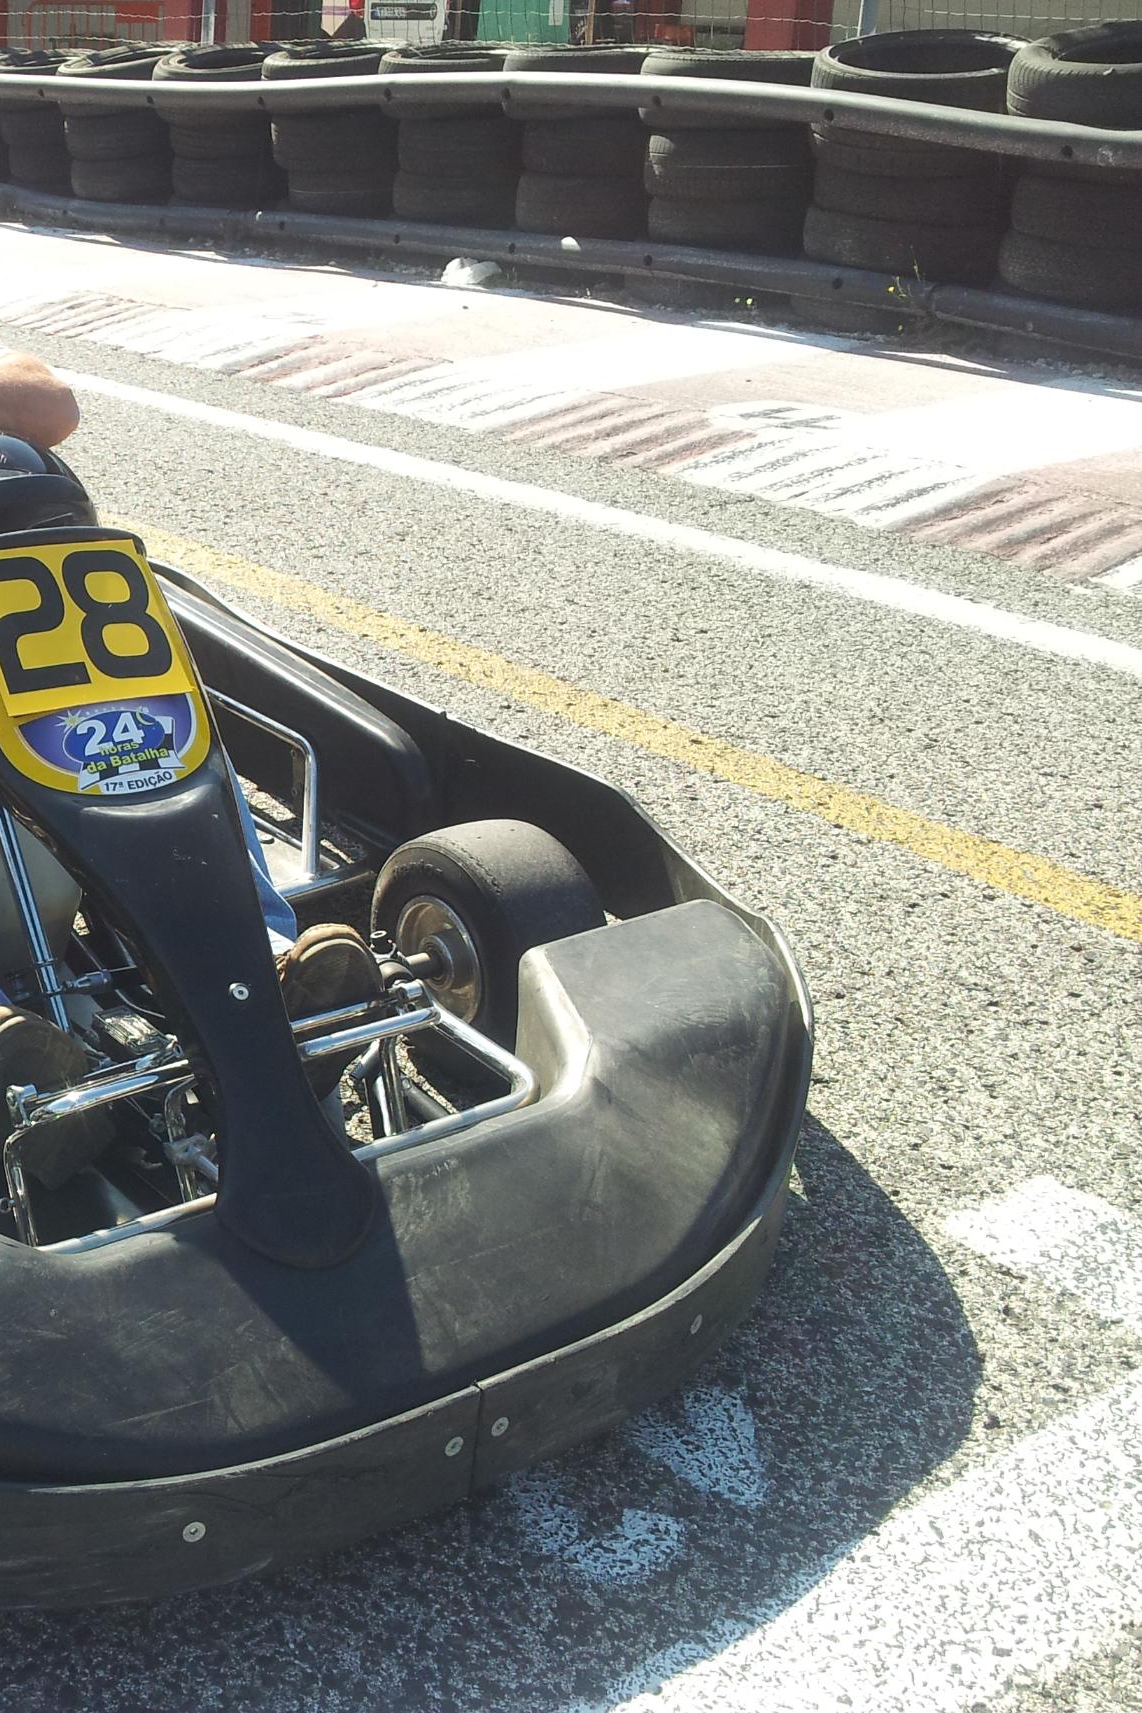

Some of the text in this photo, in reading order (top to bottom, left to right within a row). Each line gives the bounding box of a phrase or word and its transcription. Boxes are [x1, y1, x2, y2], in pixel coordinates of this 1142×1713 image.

[76, 711, 145, 756] 24
[98, 741, 139, 756] horas
[86, 748, 169, 774] da Batalha
[127, 770, 173, 790] EDIÇÃO
